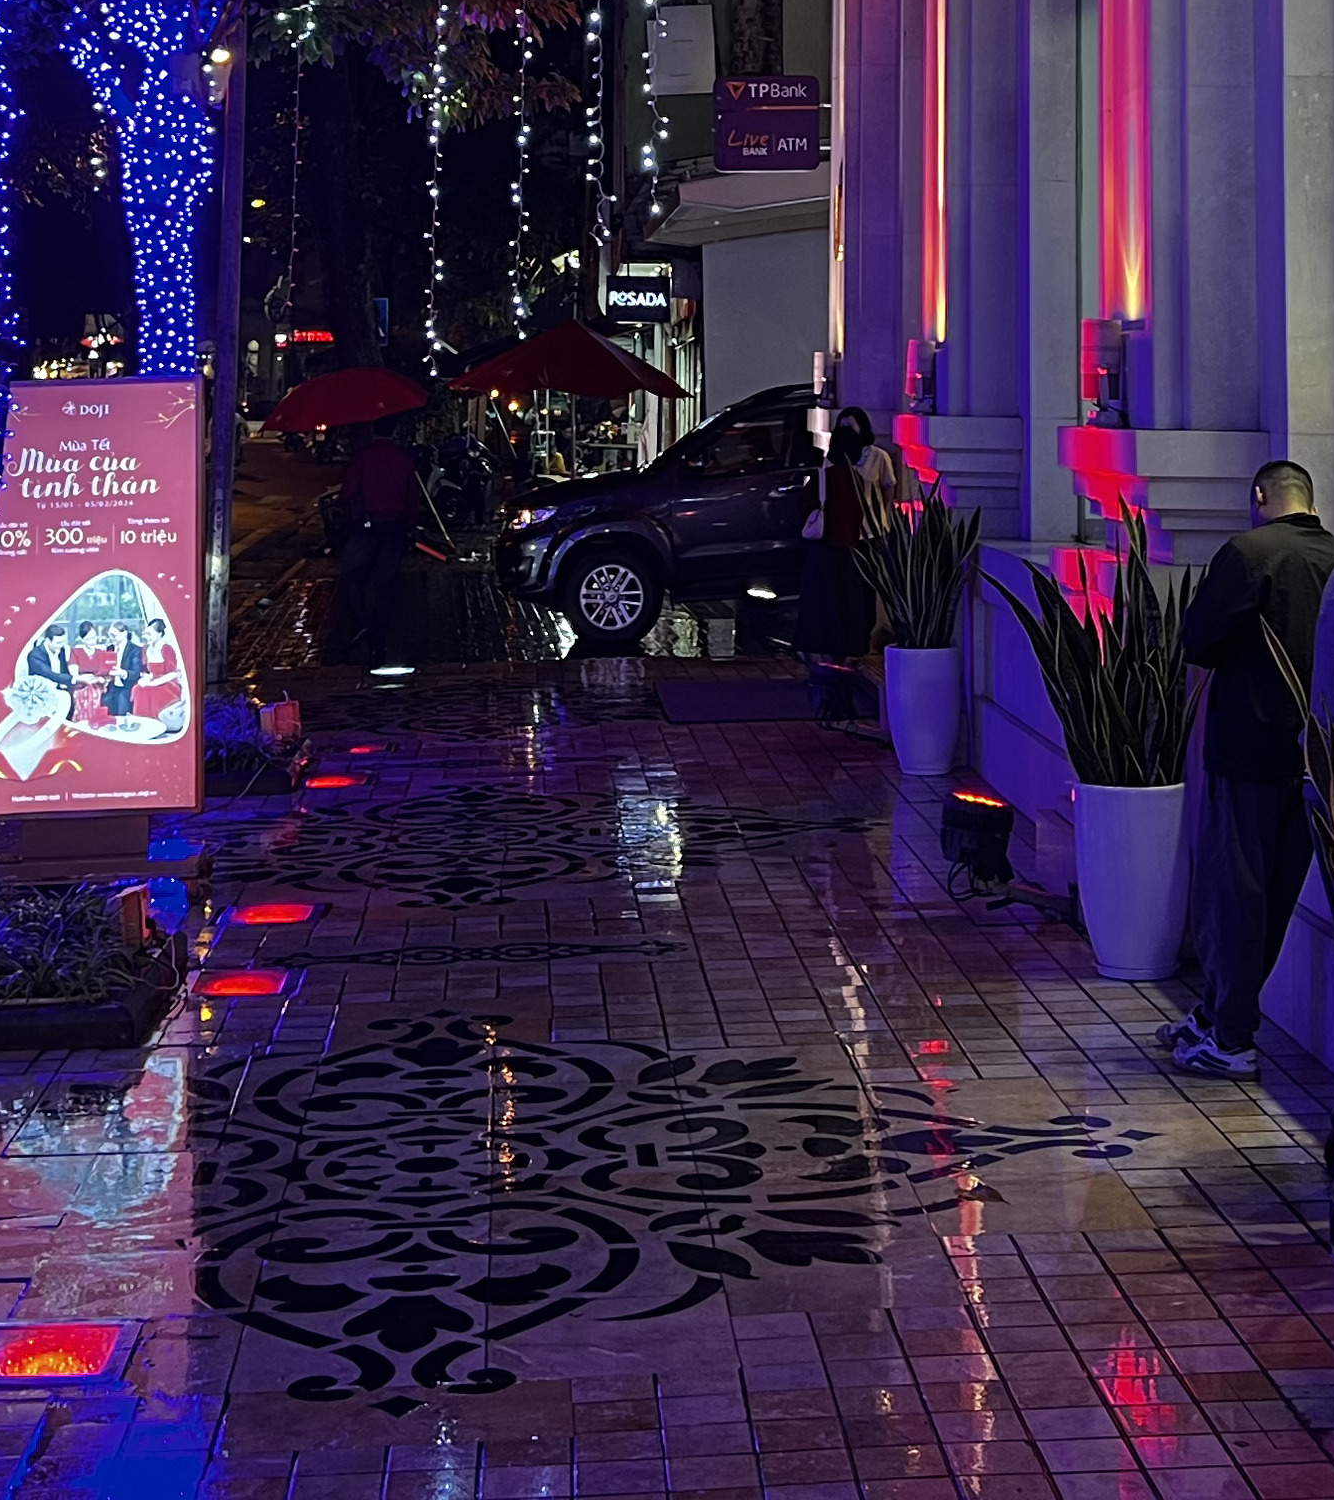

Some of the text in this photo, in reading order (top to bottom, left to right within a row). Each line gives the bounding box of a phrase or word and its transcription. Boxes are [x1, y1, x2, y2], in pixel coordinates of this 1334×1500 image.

[748, 83, 808, 98] TPBank
[742, 147, 768, 156] BANK
[777, 137, 808, 152] ATM
[79, 403, 110, 418] DOJI
[59, 437, 111, 452] Mùa Tết
[6, 447, 142, 477] Mùa của
[19, 471, 161, 499] tình thân
[43, 527, 84, 546] 300
[120, 528, 177, 546] 10 triệu
